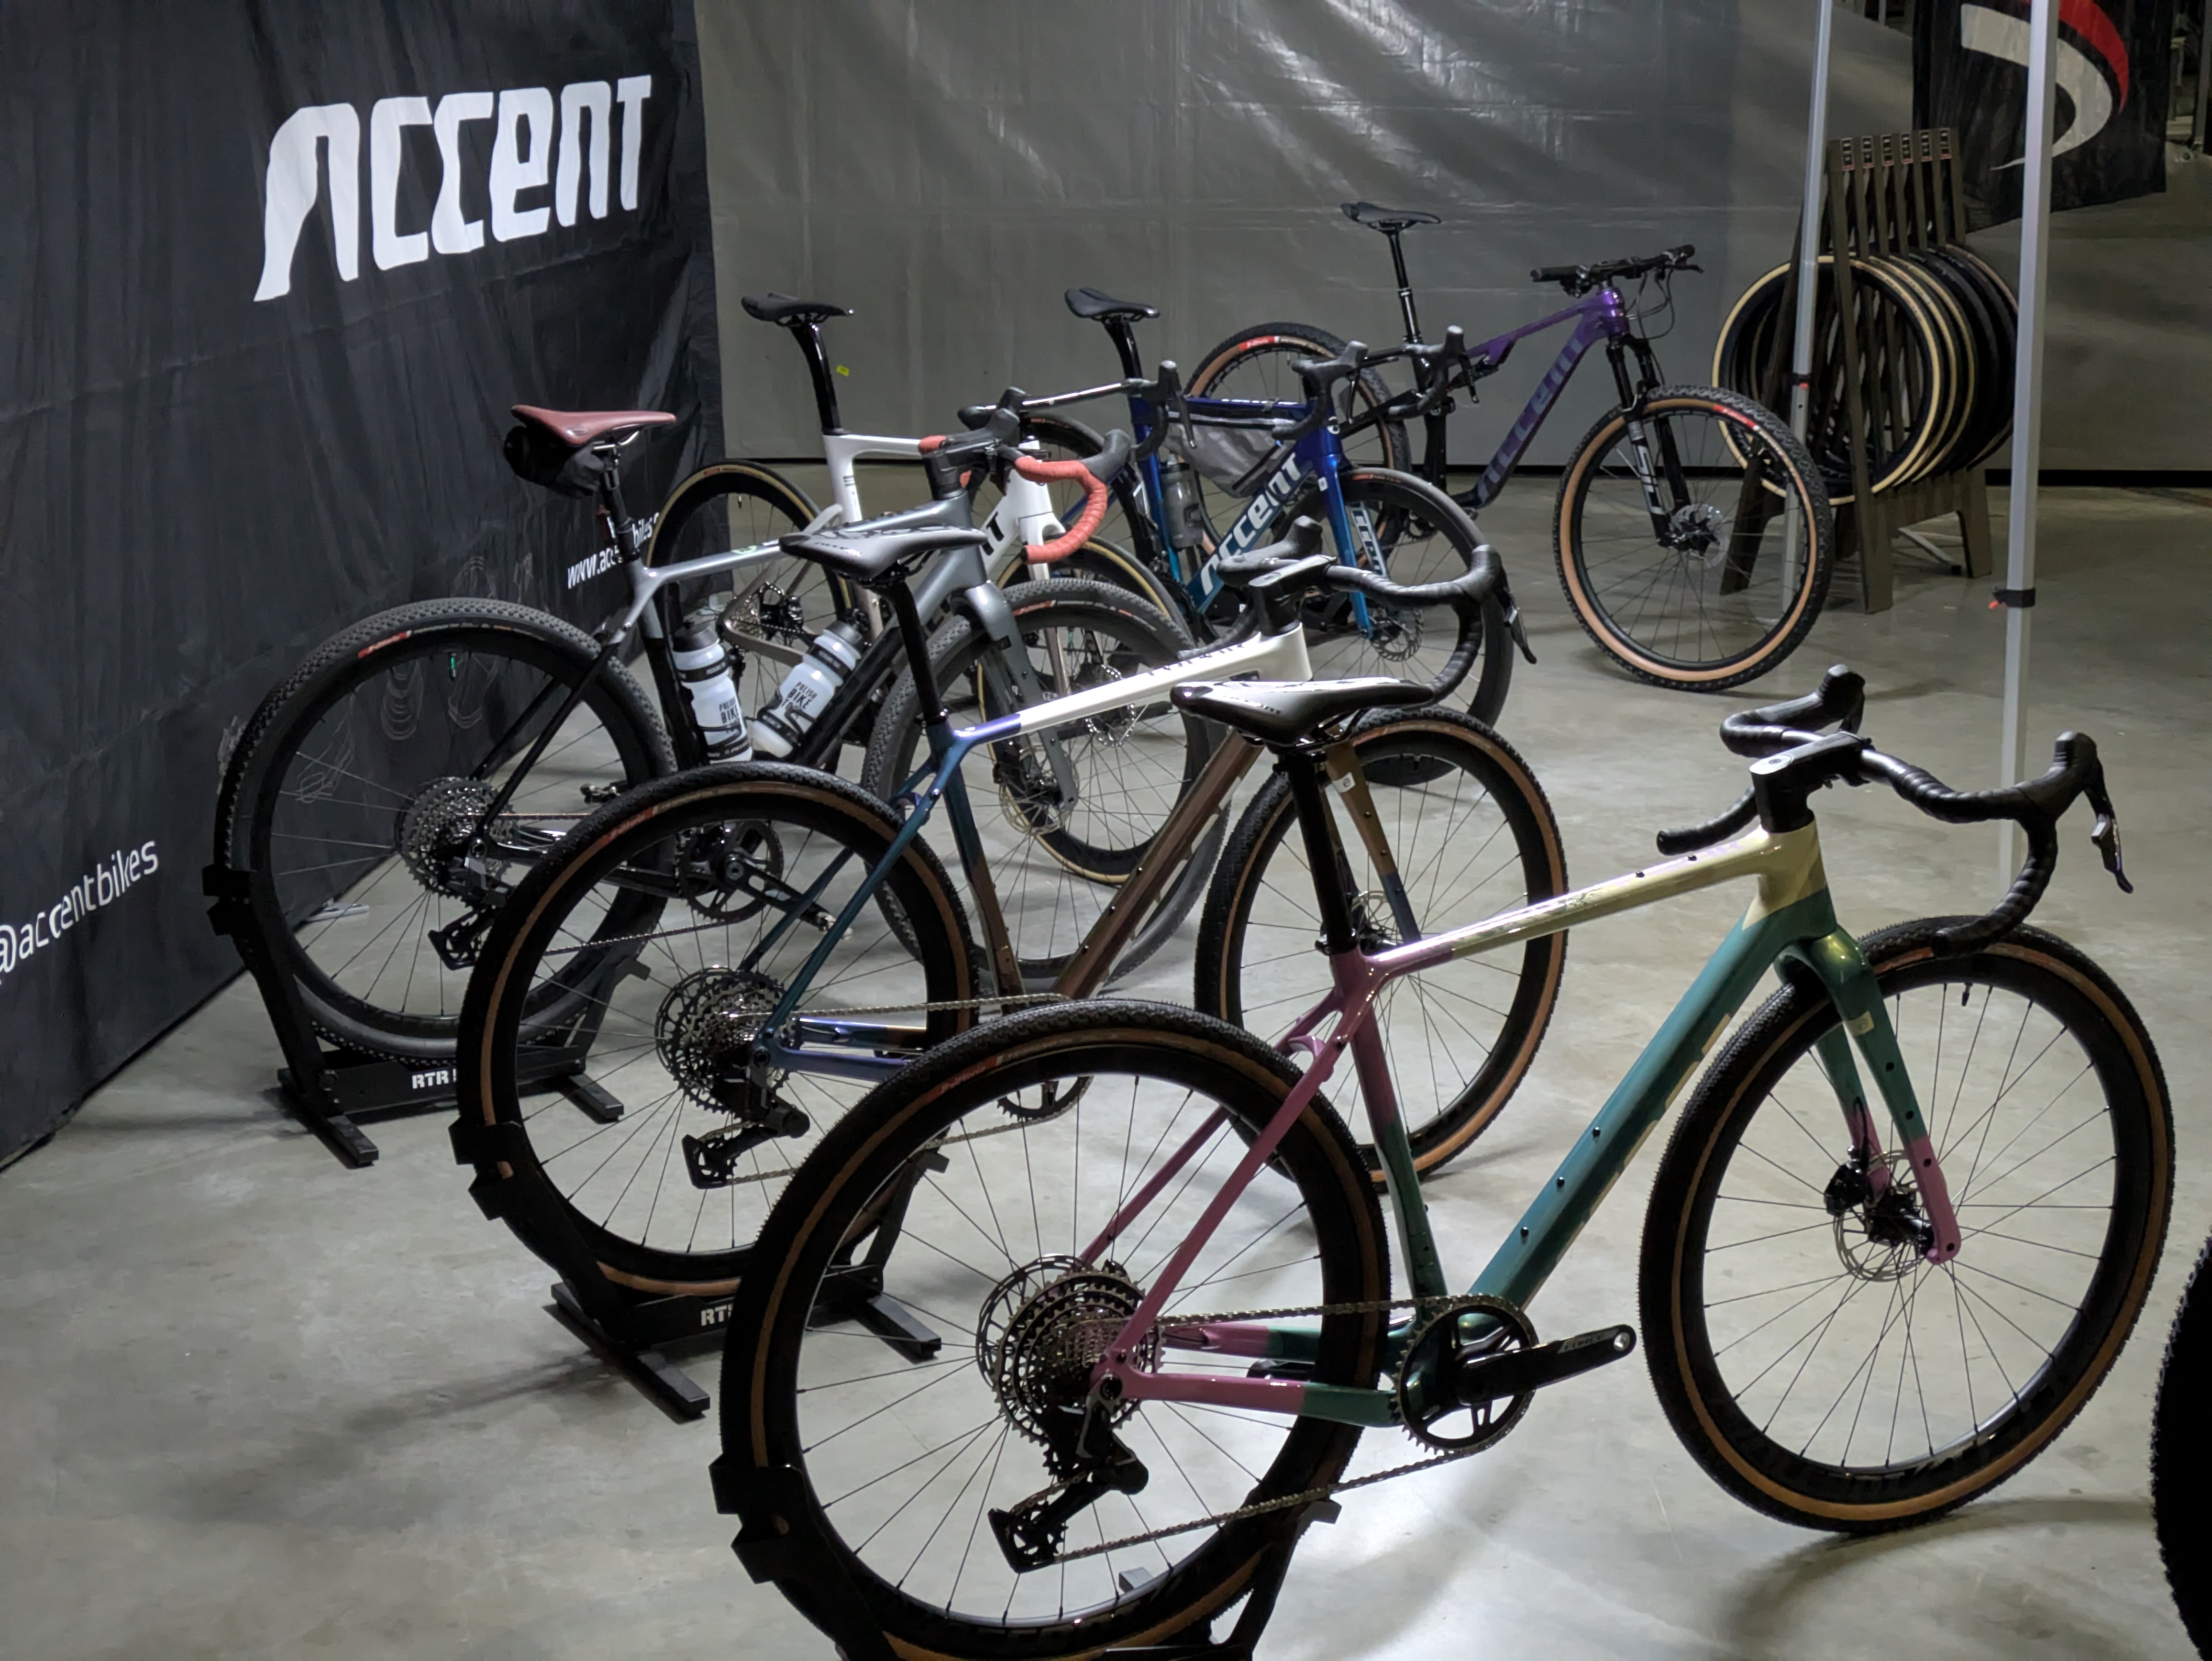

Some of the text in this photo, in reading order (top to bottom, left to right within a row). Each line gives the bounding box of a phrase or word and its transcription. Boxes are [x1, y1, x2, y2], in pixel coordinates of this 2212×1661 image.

[787, 688, 812, 709] BIKE
[795, 682, 818, 700] POLISH
[412, 1070, 450, 1089] RTR
